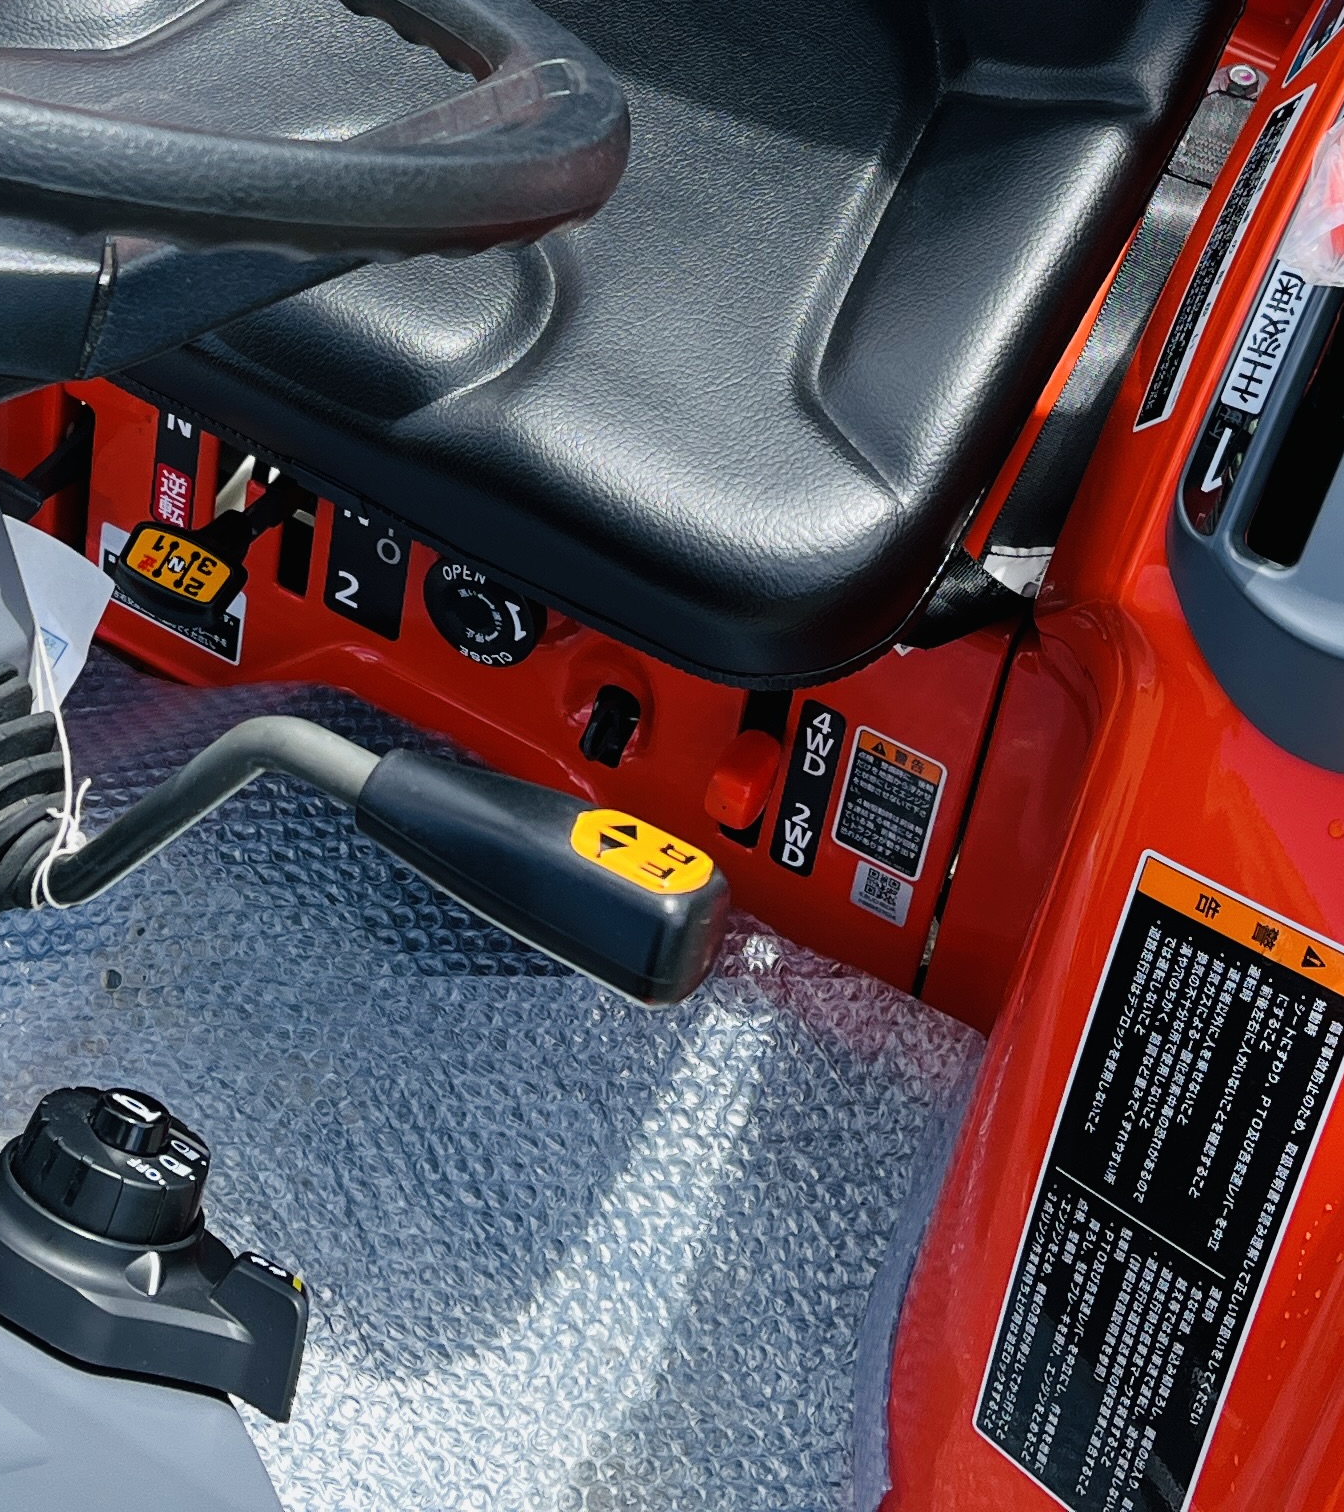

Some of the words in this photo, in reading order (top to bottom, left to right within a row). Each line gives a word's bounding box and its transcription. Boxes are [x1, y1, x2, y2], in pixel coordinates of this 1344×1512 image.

[1231, 270, 1306, 404] 主変速
[1201, 427, 1233, 493] 1
[158, 469, 188, 528] 逆転
[167, 557, 185, 572] N
[197, 557, 217, 576] 3
[443, 565, 486, 584] OPEN
[184, 577, 205, 597] 2
[335, 570, 359, 609] 2
[459, 645, 513, 664] CLOSE
[803, 712, 834, 777] 4WD
[893, 749, 925, 775] 警告
[781, 802, 813, 868] 2WD
[1192, 890, 1281, 953] 警告
[1133, 933, 1176, 1037] では運転しないこと
[1238, 962, 1261, 1003] 運転時
[1258, 992, 1288, 1054] にすること
[1303, 997, 1327, 1037] 始動時
[1200, 1284, 1223, 1324] 運転時
